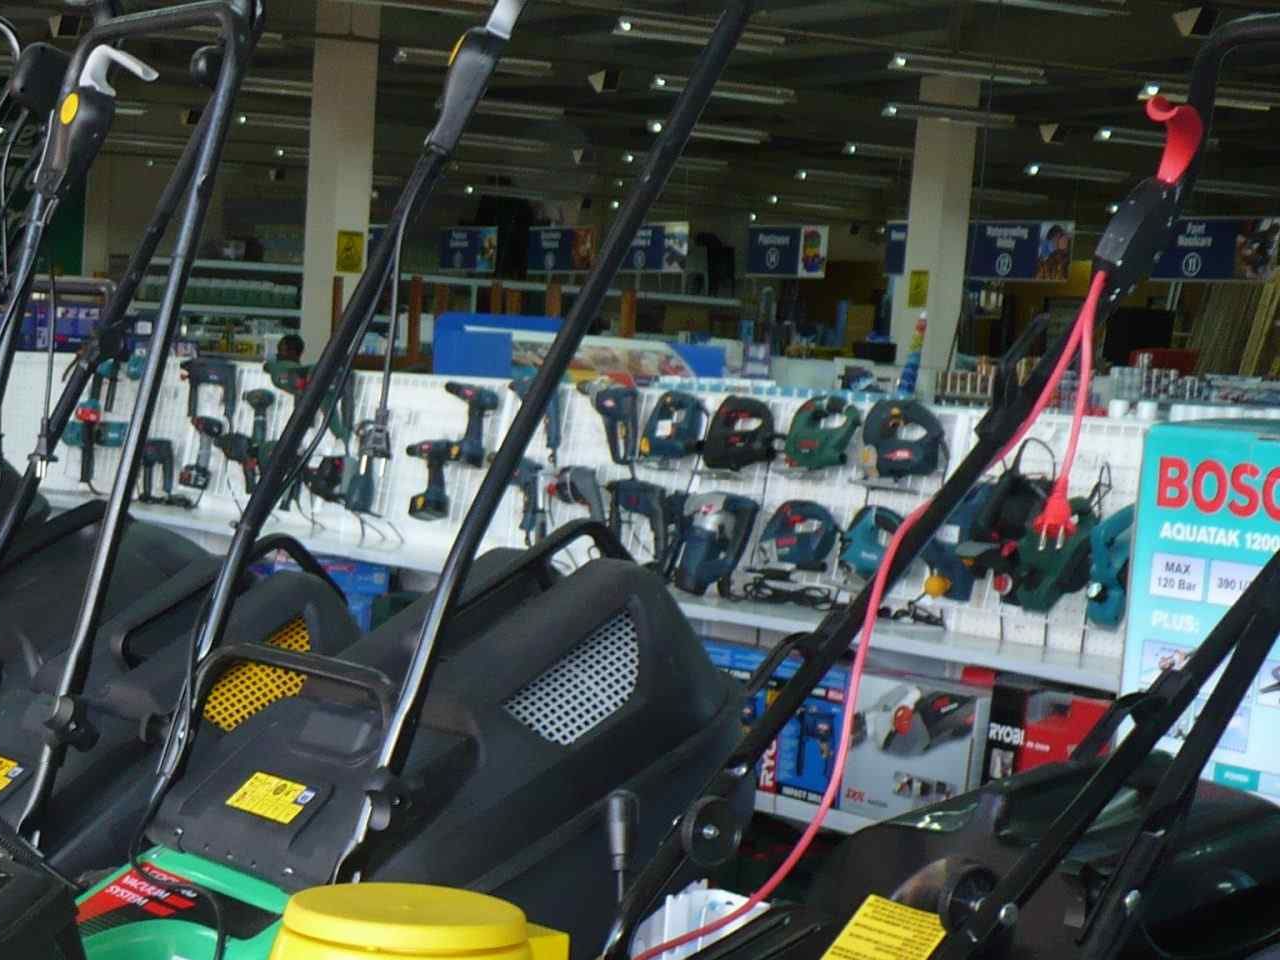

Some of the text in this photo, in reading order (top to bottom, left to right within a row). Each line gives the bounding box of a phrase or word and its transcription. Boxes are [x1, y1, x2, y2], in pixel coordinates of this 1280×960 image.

[1160, 521, 1240, 549] AQUATAK
[1165, 561, 1191, 574] MAX
[1177, 579, 1197, 592] Bar
[989, 722, 1025, 746] RYOBI
